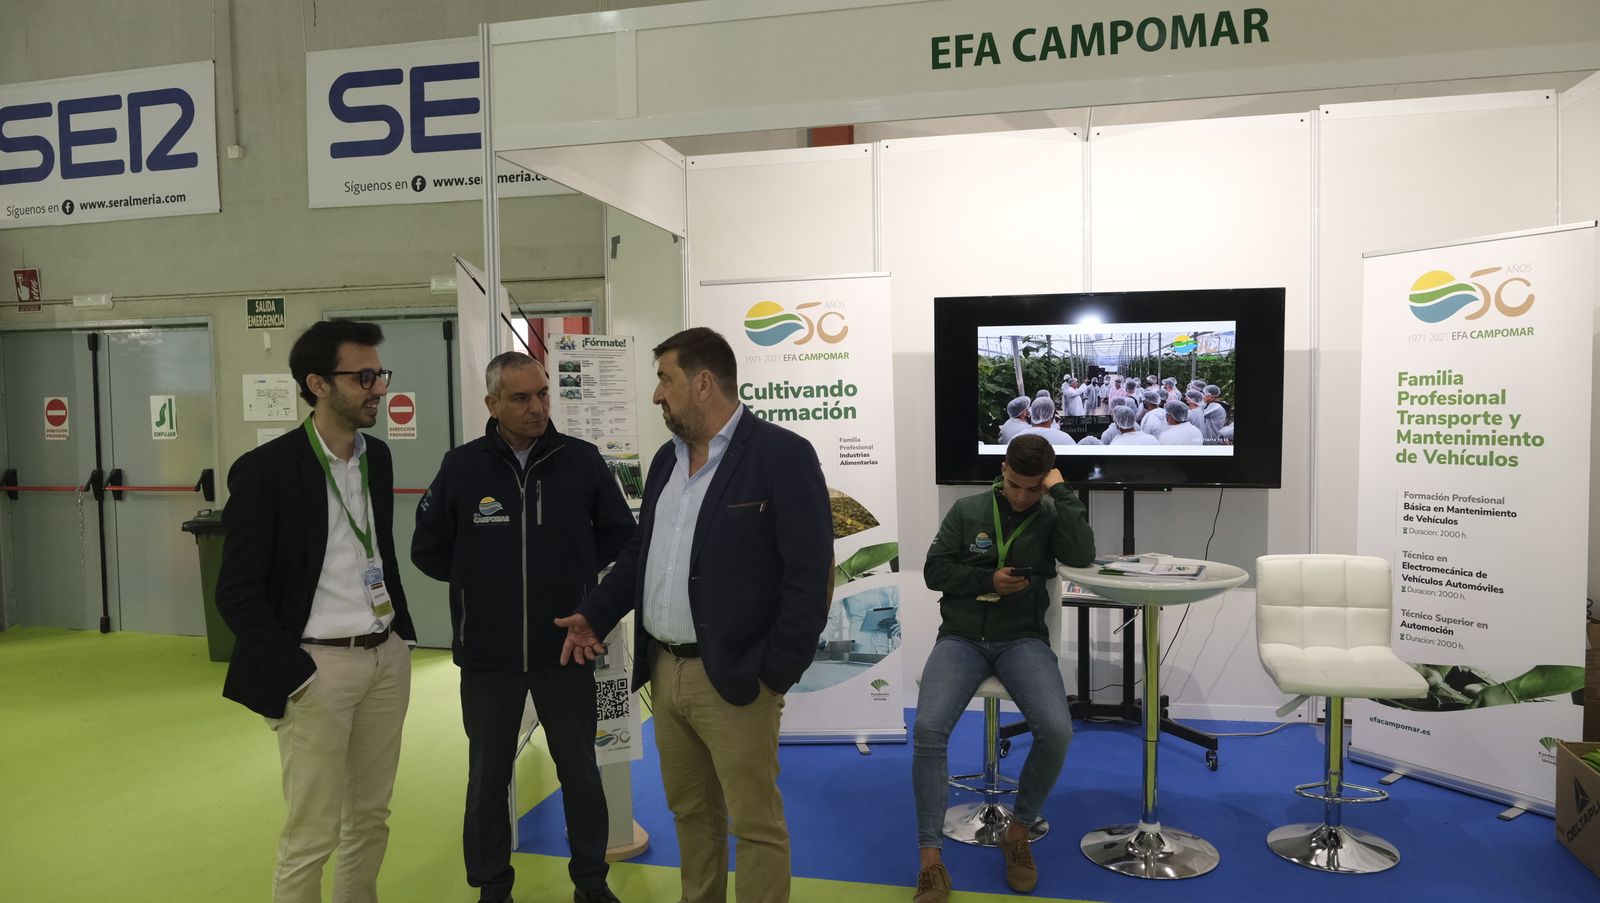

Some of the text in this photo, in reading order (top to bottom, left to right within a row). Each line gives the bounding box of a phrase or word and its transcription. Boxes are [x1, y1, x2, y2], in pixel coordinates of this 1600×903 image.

[931, 7, 1270, 70] EFA CAMPOMAR
[328, 61, 482, 159] SE
[0, 87, 198, 185] SER
[344, 180, 392, 195] Síguenos
[395, 180, 408, 190] en
[6, 205, 46, 218] Síguenos
[48, 206, 59, 214] en
[80, 193, 186, 211] www.seralmeria.com
[1505, 263, 1533, 274] AÑOS
[255, 300, 276, 313] SALIDA
[248, 314, 285, 327] EMERGENCIA
[1451, 331, 1468, 341] EFA
[1470, 326, 1534, 339] CAMPOMAR
[582, 337, 627, 348] ¡Fórmate!
[783, 353, 797, 362] EFA
[799, 352, 850, 361] CAMPOMAR
[1397, 369, 1464, 387] Familia
[739, 379, 858, 401] Cultivando
[1397, 388, 1507, 406] Profesional
[747, 401, 857, 422] ormación
[1396, 410, 1522, 429] Transporte y
[1396, 429, 1545, 447] Mantenimiento
[839, 451, 870, 459] Industrias
[1395, 448, 1519, 467] de Vehículos
[1404, 491, 1505, 505] Formación Profesional
[1403, 502, 1431, 512] Básica
[1446, 505, 1518, 518] Mantenimiento
[1403, 514, 1459, 525] de Vehículos
[1440, 530, 1461, 539] 2000
[1402, 550, 1435, 561] Técnico
[1402, 561, 1488, 579] Electromecánica de
[1401, 573, 1504, 594] Vehículos Automóviles
[1438, 589, 1459, 600] 2000
[1401, 608, 1488, 630] Técnico Superior en
[1400, 620, 1454, 636] Automoción
[1436, 638, 1458, 649] 2000
[1369, 716, 1431, 735] efacampomar.es
